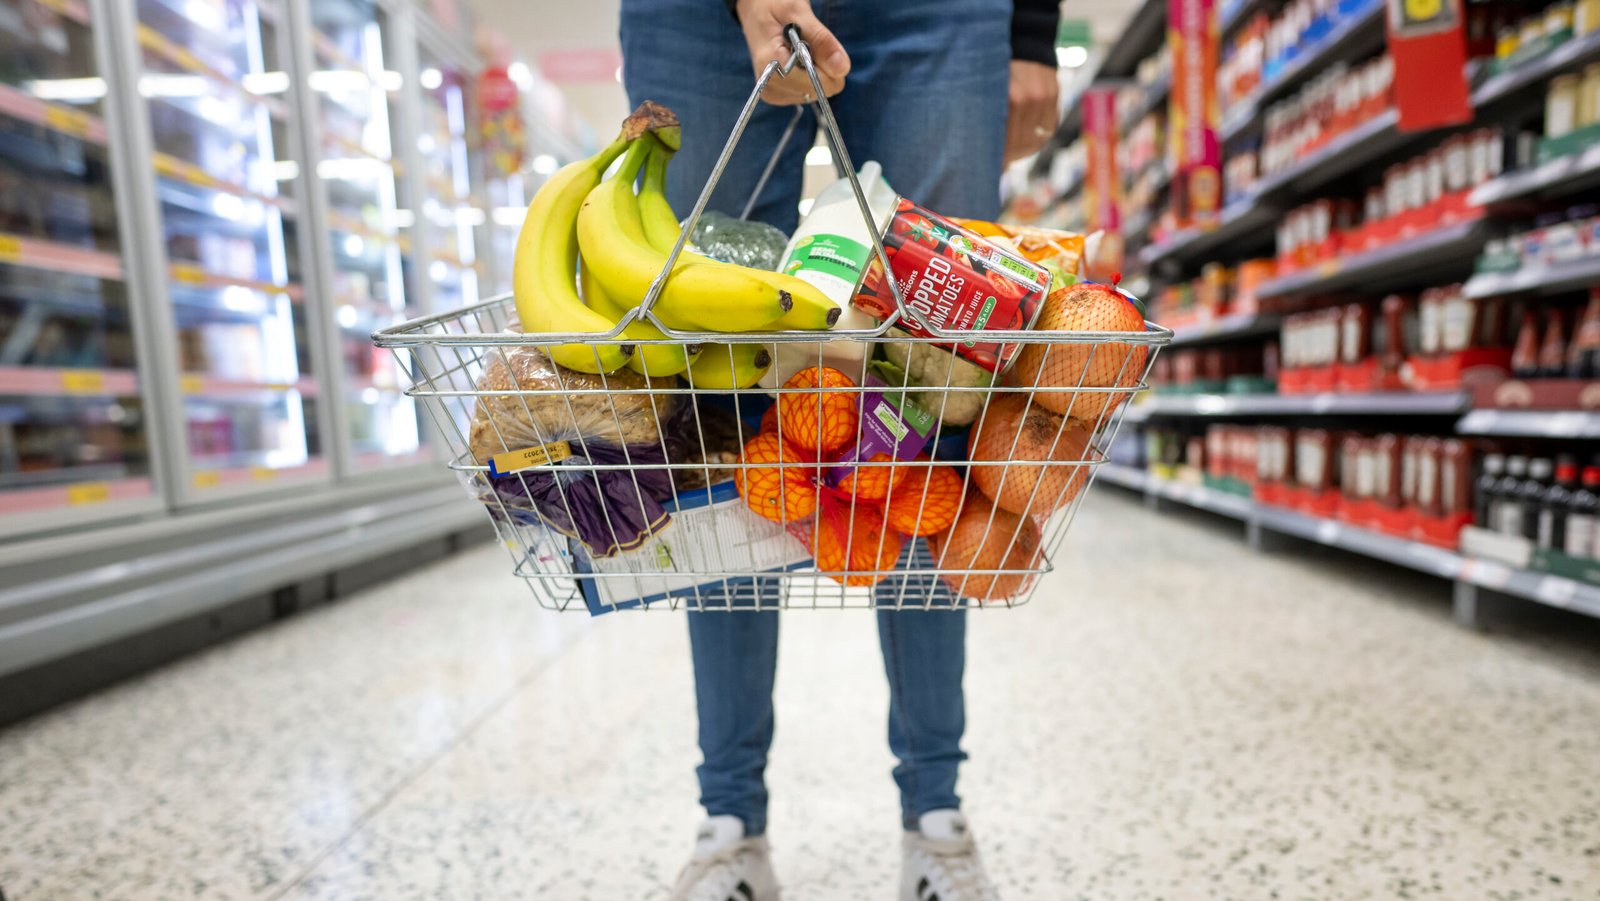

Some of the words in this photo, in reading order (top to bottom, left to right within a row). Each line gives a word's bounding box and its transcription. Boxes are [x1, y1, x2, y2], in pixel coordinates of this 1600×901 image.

[902, 269, 919, 301] rrisons
[928, 273, 965, 330] OMATOES
[958, 310, 974, 331] OMATO
[970, 290, 984, 311] JUICE
[979, 316, 986, 324] 5
[984, 302, 992, 313] DAY
